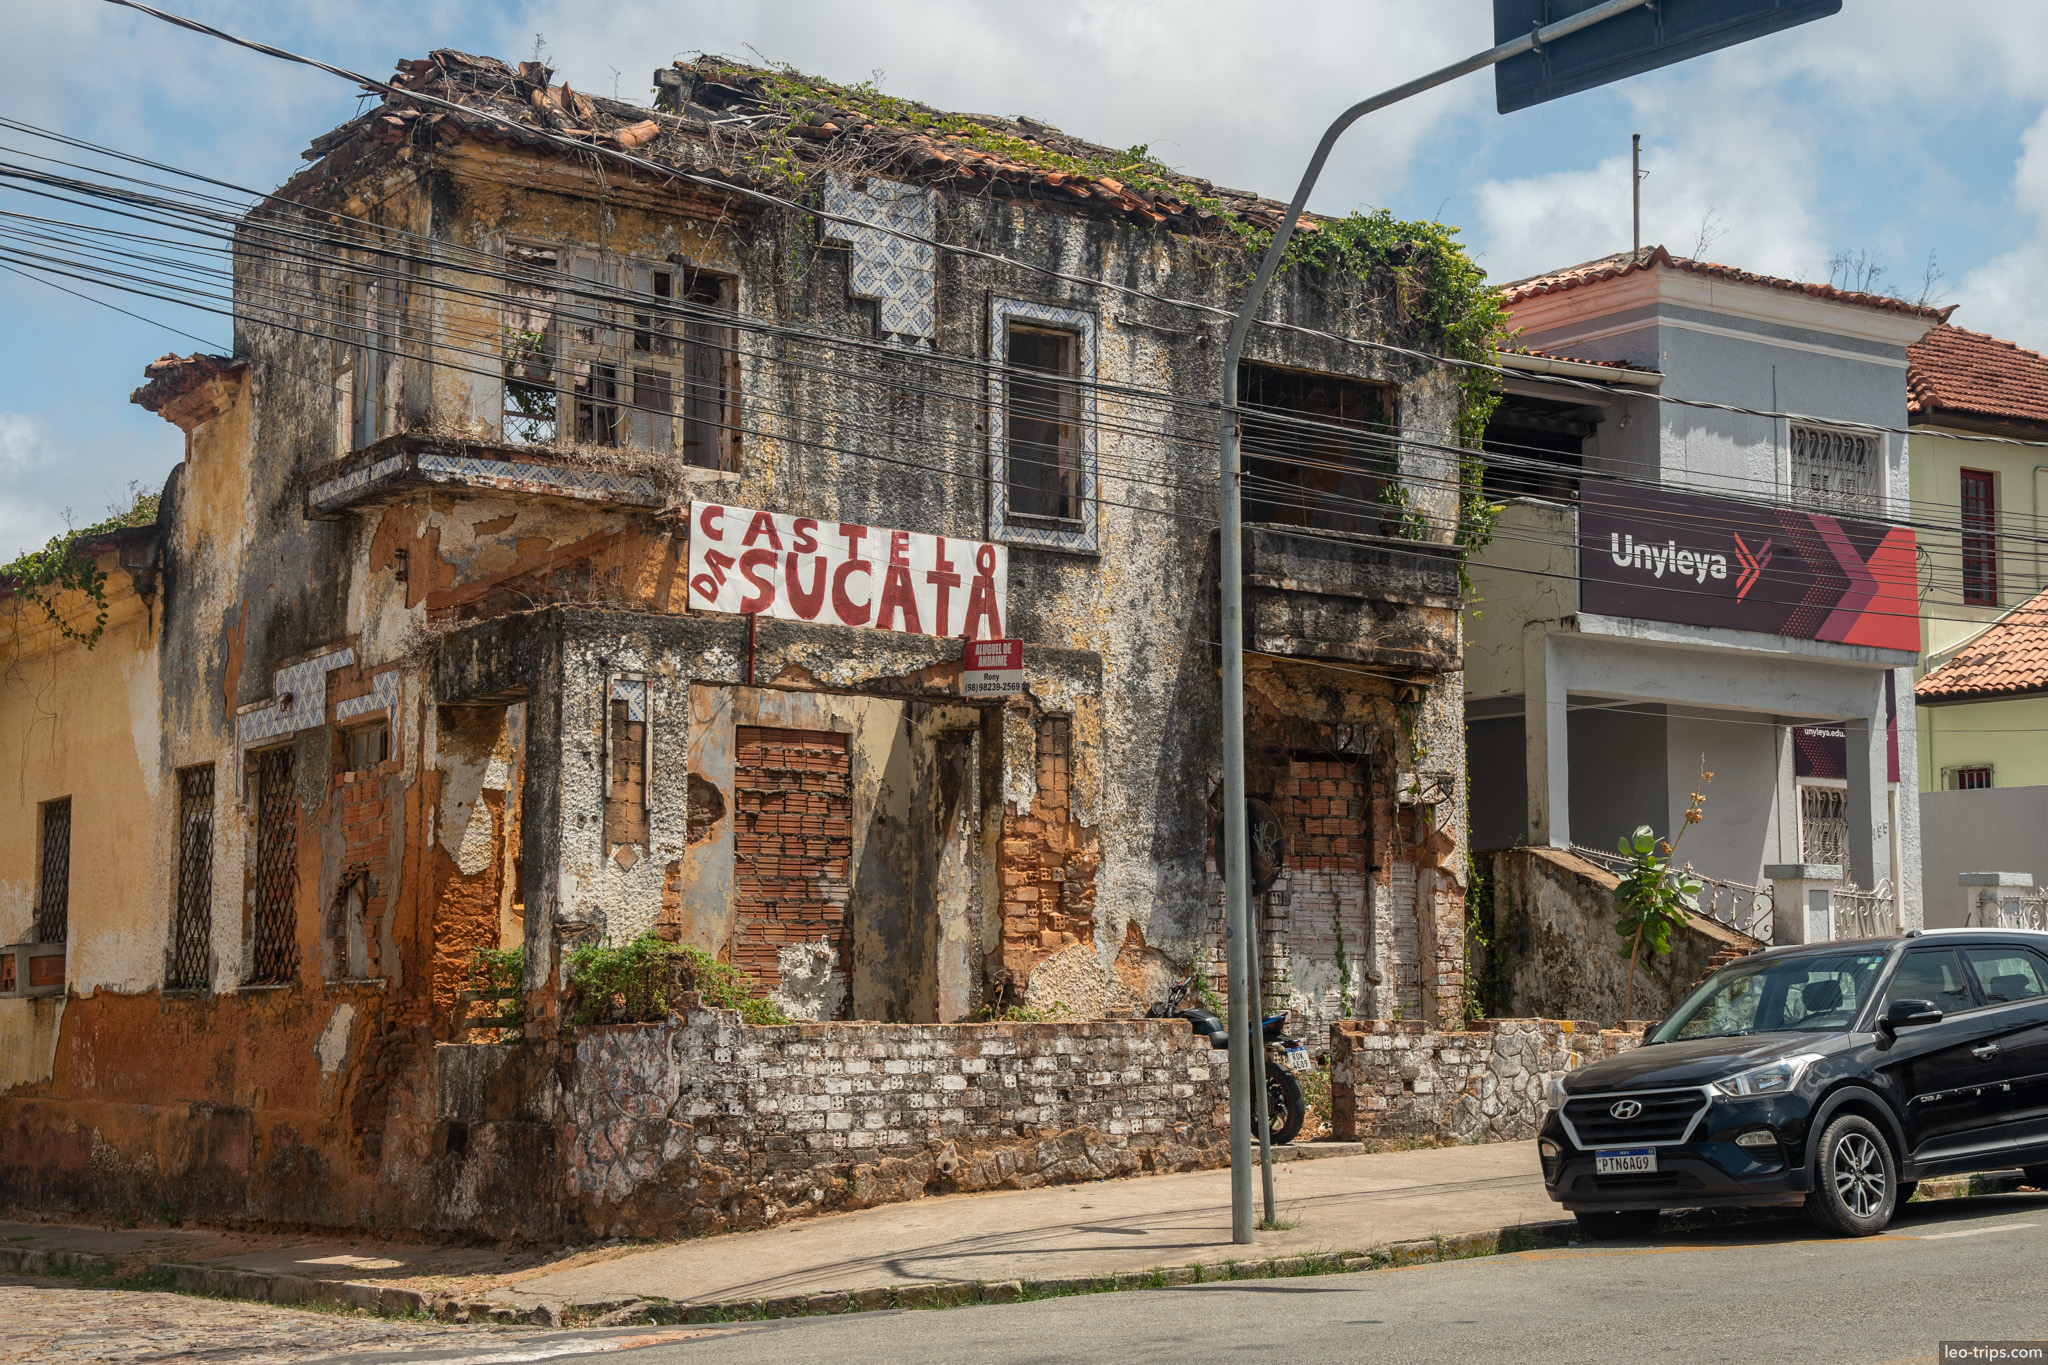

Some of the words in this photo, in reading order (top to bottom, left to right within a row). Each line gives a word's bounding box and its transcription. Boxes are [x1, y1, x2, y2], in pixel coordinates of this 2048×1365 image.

[700, 505, 996, 577] CASTELO
[1611, 532, 1727, 584] Unyleya
[690, 548, 736, 604] DA
[739, 548, 1003, 640] SUCATA
[975, 643, 1002, 656] ALUGUEL
[1003, 643, 1012, 654] DE
[978, 655, 1007, 667] ANDAIME
[984, 673, 1000, 682] Rony
[1602, 1156, 1649, 1171] PTN6A09
